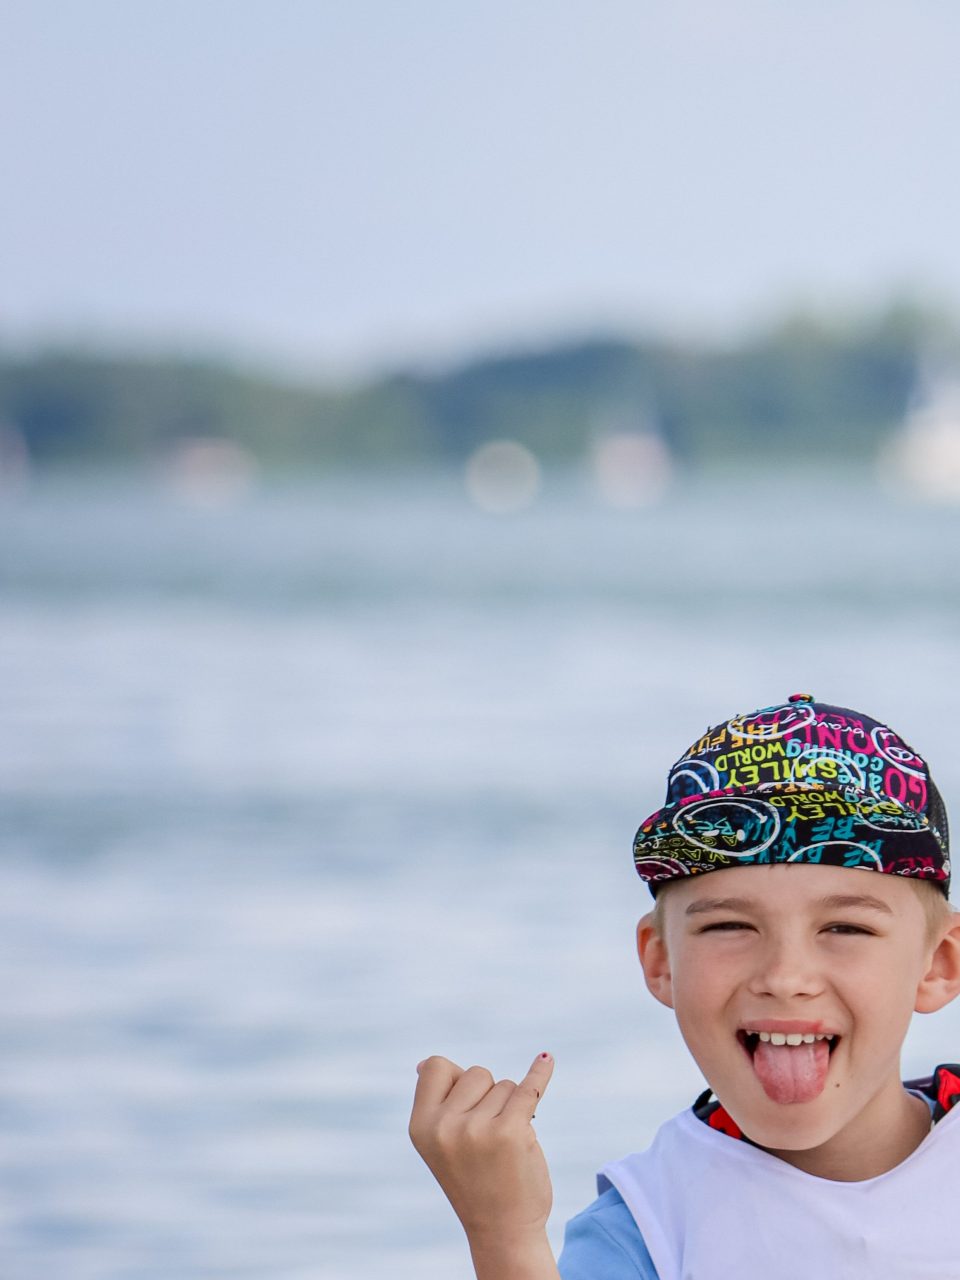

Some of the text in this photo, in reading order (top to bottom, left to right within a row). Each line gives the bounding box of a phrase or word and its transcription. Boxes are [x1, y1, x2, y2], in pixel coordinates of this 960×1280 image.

[715, 741, 787, 772] WORLD
[726, 757, 839, 789] SMILEY
[768, 791, 843, 808] WORLD
